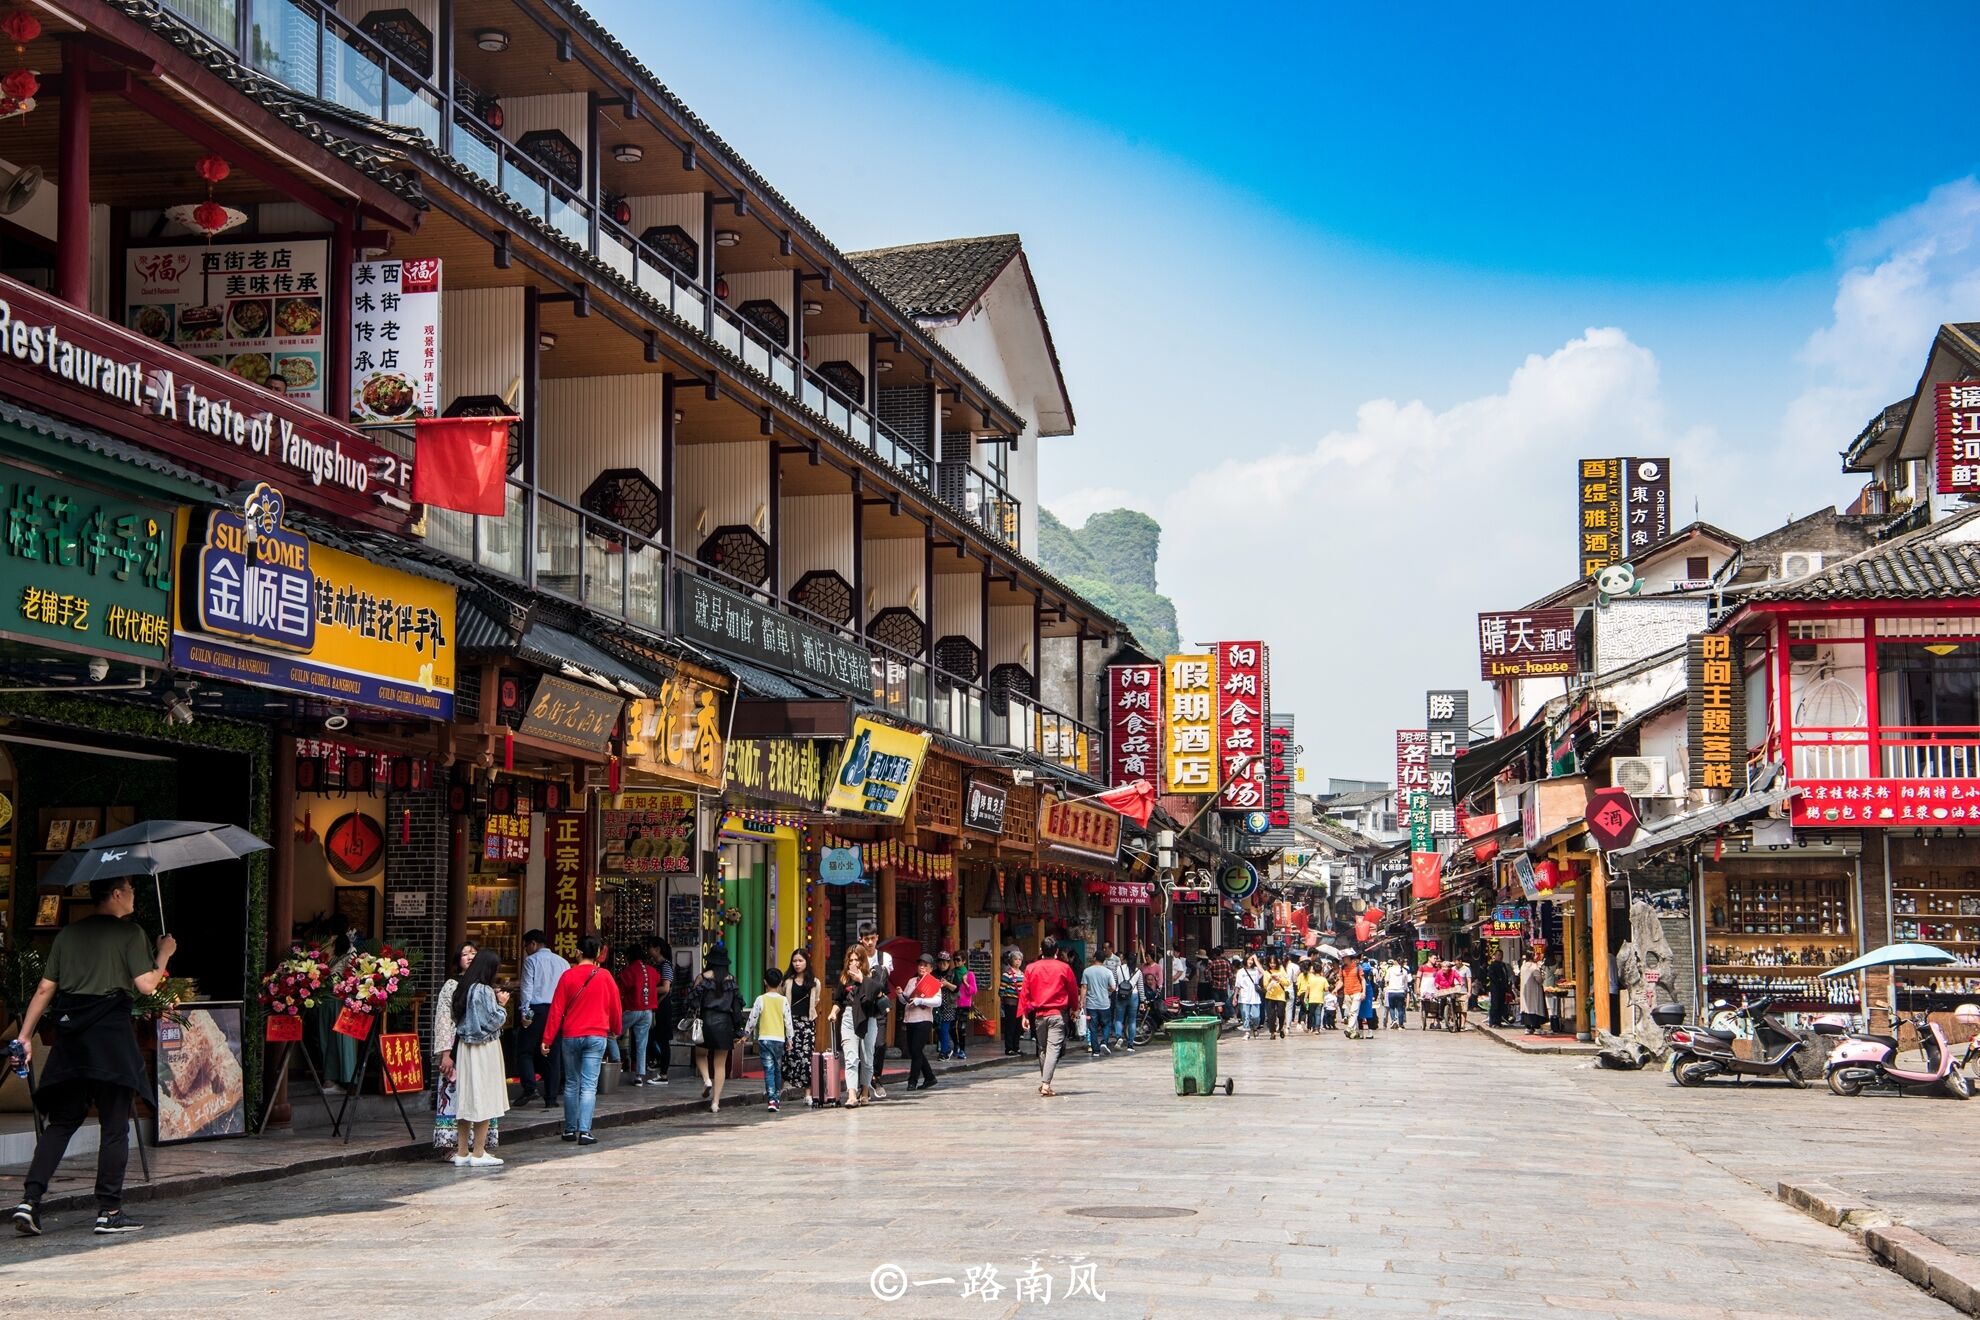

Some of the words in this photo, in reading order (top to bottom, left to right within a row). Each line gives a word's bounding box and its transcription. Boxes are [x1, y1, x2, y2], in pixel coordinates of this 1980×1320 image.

[201, 248, 292, 271] 西街老店
[225, 272, 318, 297] 美味传承
[354, 264, 377, 372] 美味传承
[380, 263, 401, 369] 西街老店
[187, 385, 246, 446] taste
[251, 412, 273, 456] of
[280, 417, 368, 493] Yangshuo
[23, 586, 90, 631] 老铺手艺
[208, 557, 310, 637] 金顺昌
[314, 576, 446, 661] 桂林桂花伴手礼
[108, 604, 169, 648] 代代相传
[190, 646, 212, 664] GUILIN
[213, 651, 237, 670] GUIHUA
[237, 655, 271, 676] BANSHOULI
[290, 667, 310, 683] GUILIN
[310, 671, 331, 688] GUIHUA
[331, 674, 362, 695] BANSHOULI
[1491, 662, 1521, 676] Live
[1526, 660, 1569, 674] house
[378, 686, 396, 700] GUILIN
[396, 689, 415, 704] GUIHUA
[415, 692, 441, 710] BANSHOULI
[1702, 635, 1733, 788] 时间主题客栈
[1171, 660, 1211, 785] 假期酒店
[1221, 645, 1258, 807] 阳朔食品商场
[1270, 727, 1291, 825] feeling
[1428, 694, 1457, 835] 勝記粉庫
[1801, 785, 1891, 800] 正宗桂林米粉
[1805, 806, 1820, 820] 粥
[1900, 805, 1931, 820] 豆浆
[1602, 808, 1623, 828] 酒
[623, 856, 690, 873] 全场免费吃
[554, 818, 582, 959] 正宗名优特
